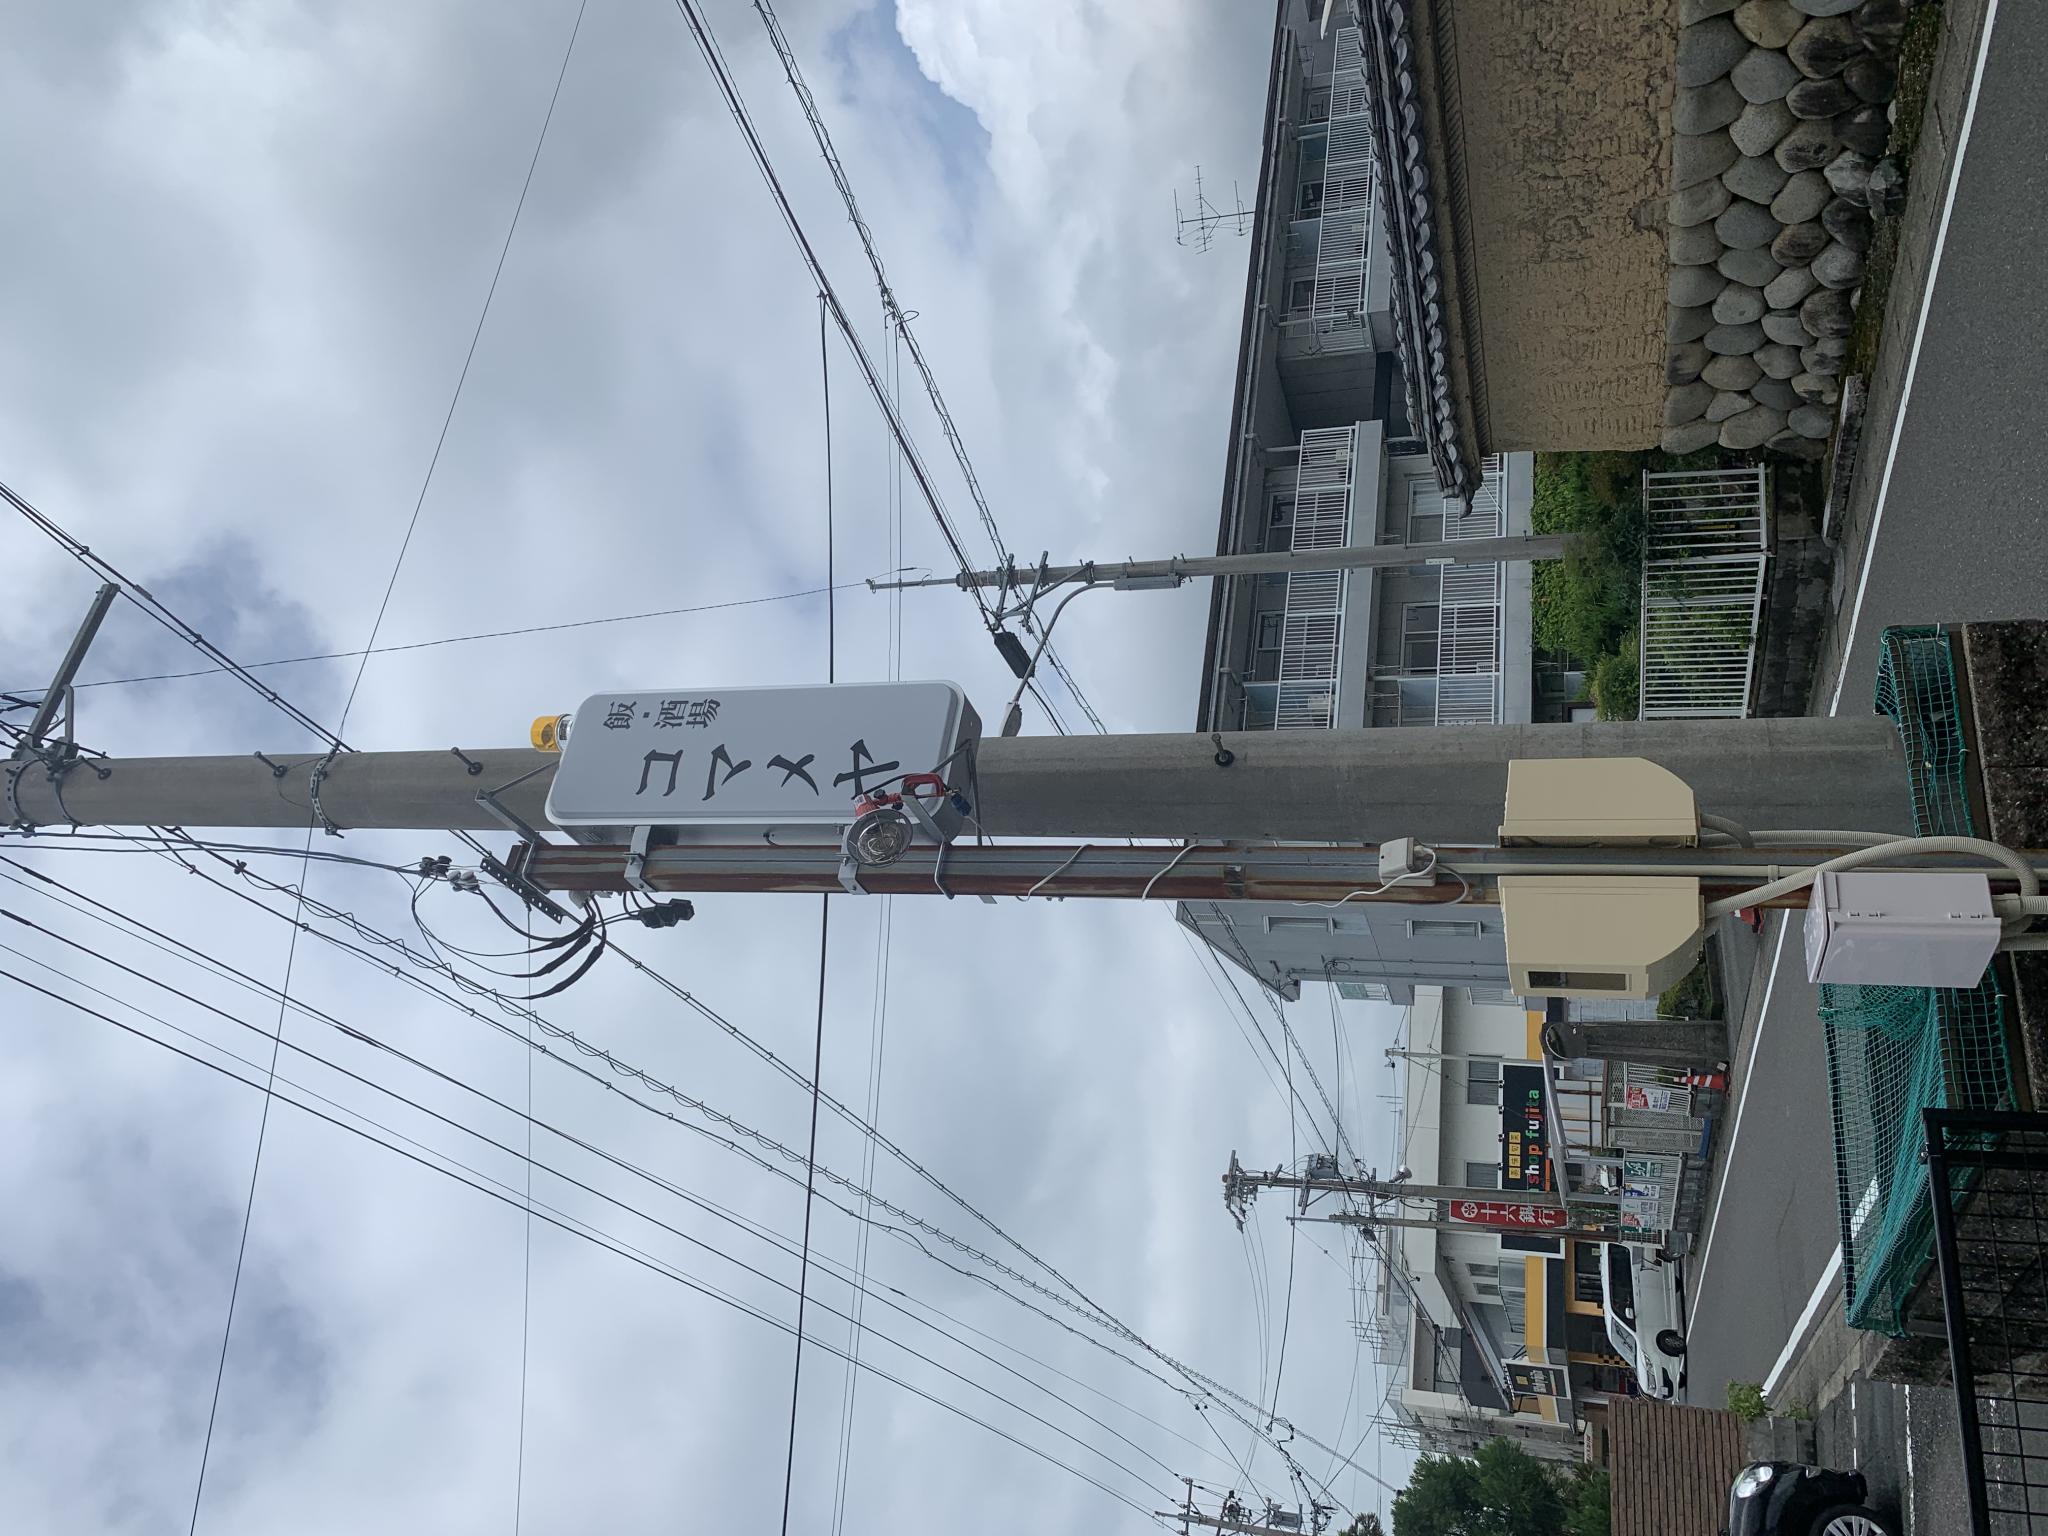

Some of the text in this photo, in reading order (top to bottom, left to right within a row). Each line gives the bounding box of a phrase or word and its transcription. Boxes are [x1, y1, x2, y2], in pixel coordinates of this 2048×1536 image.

[602, 698, 721, 730] 飯・酒場
[635, 739, 899, 801] コマメヤ
[1525, 1089, 1544, 1139] fujita
[1525, 1144, 1543, 1185] shop
[1480, 1203, 1555, 1225] 十六銀行
